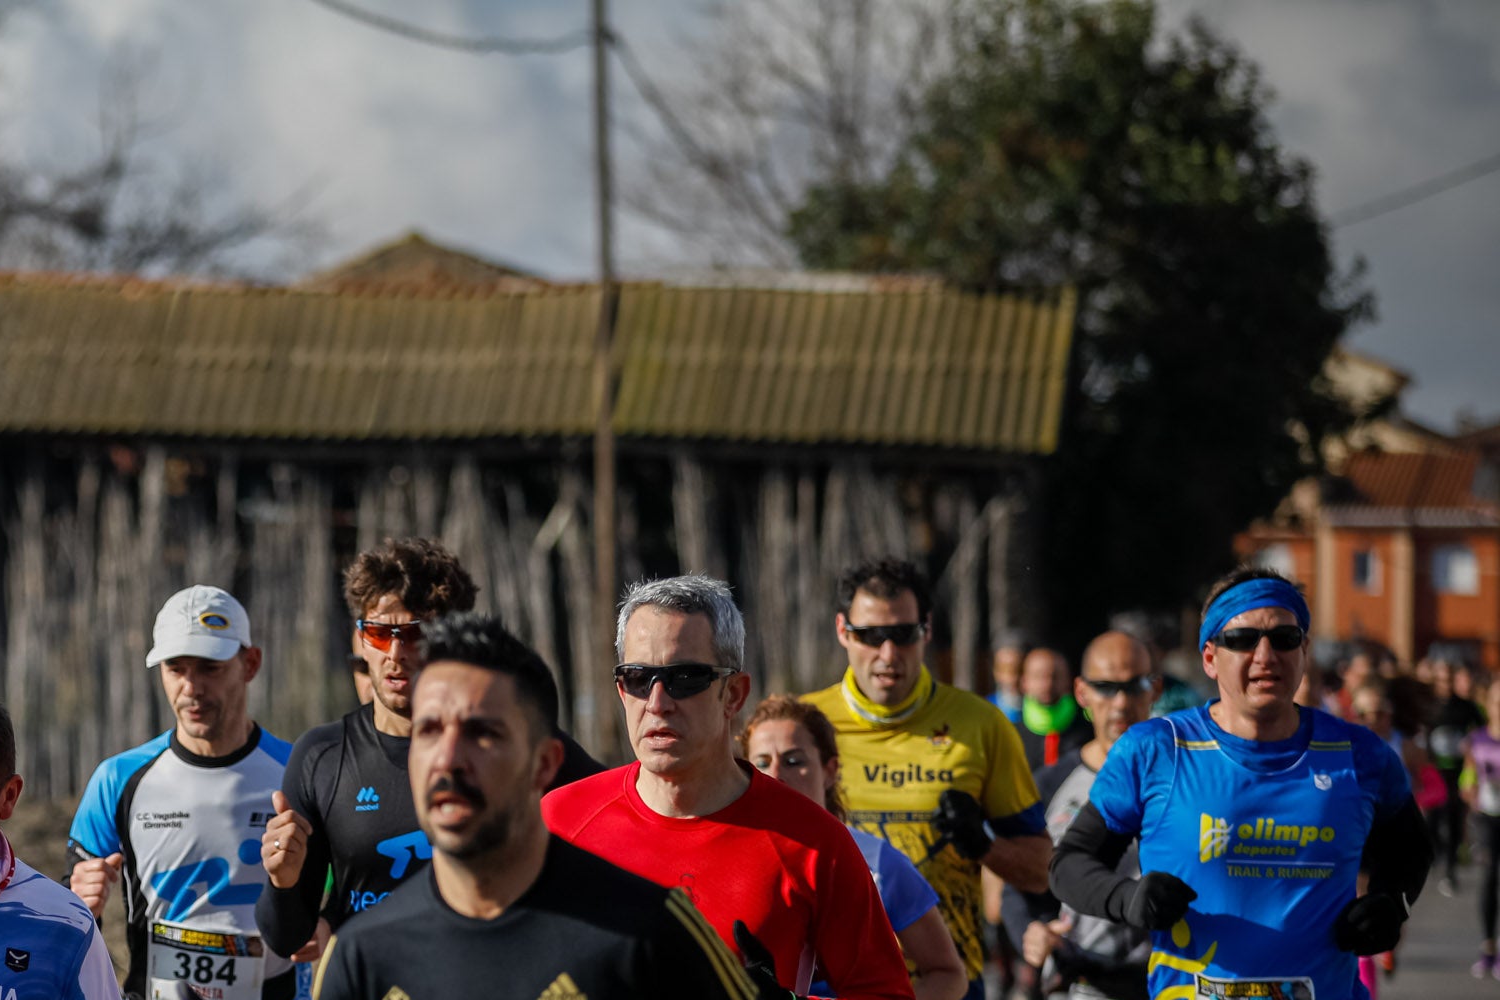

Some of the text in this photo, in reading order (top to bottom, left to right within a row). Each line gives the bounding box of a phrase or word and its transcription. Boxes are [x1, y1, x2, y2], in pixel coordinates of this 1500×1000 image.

[863, 764, 954, 787] Vigilsa
[1237, 818, 1336, 847] olimpo
[1233, 843, 1296, 856] deportes
[1226, 865, 1262, 877] TRAIL
[1266, 867, 1275, 877] &
[173, 952, 237, 986] 384
